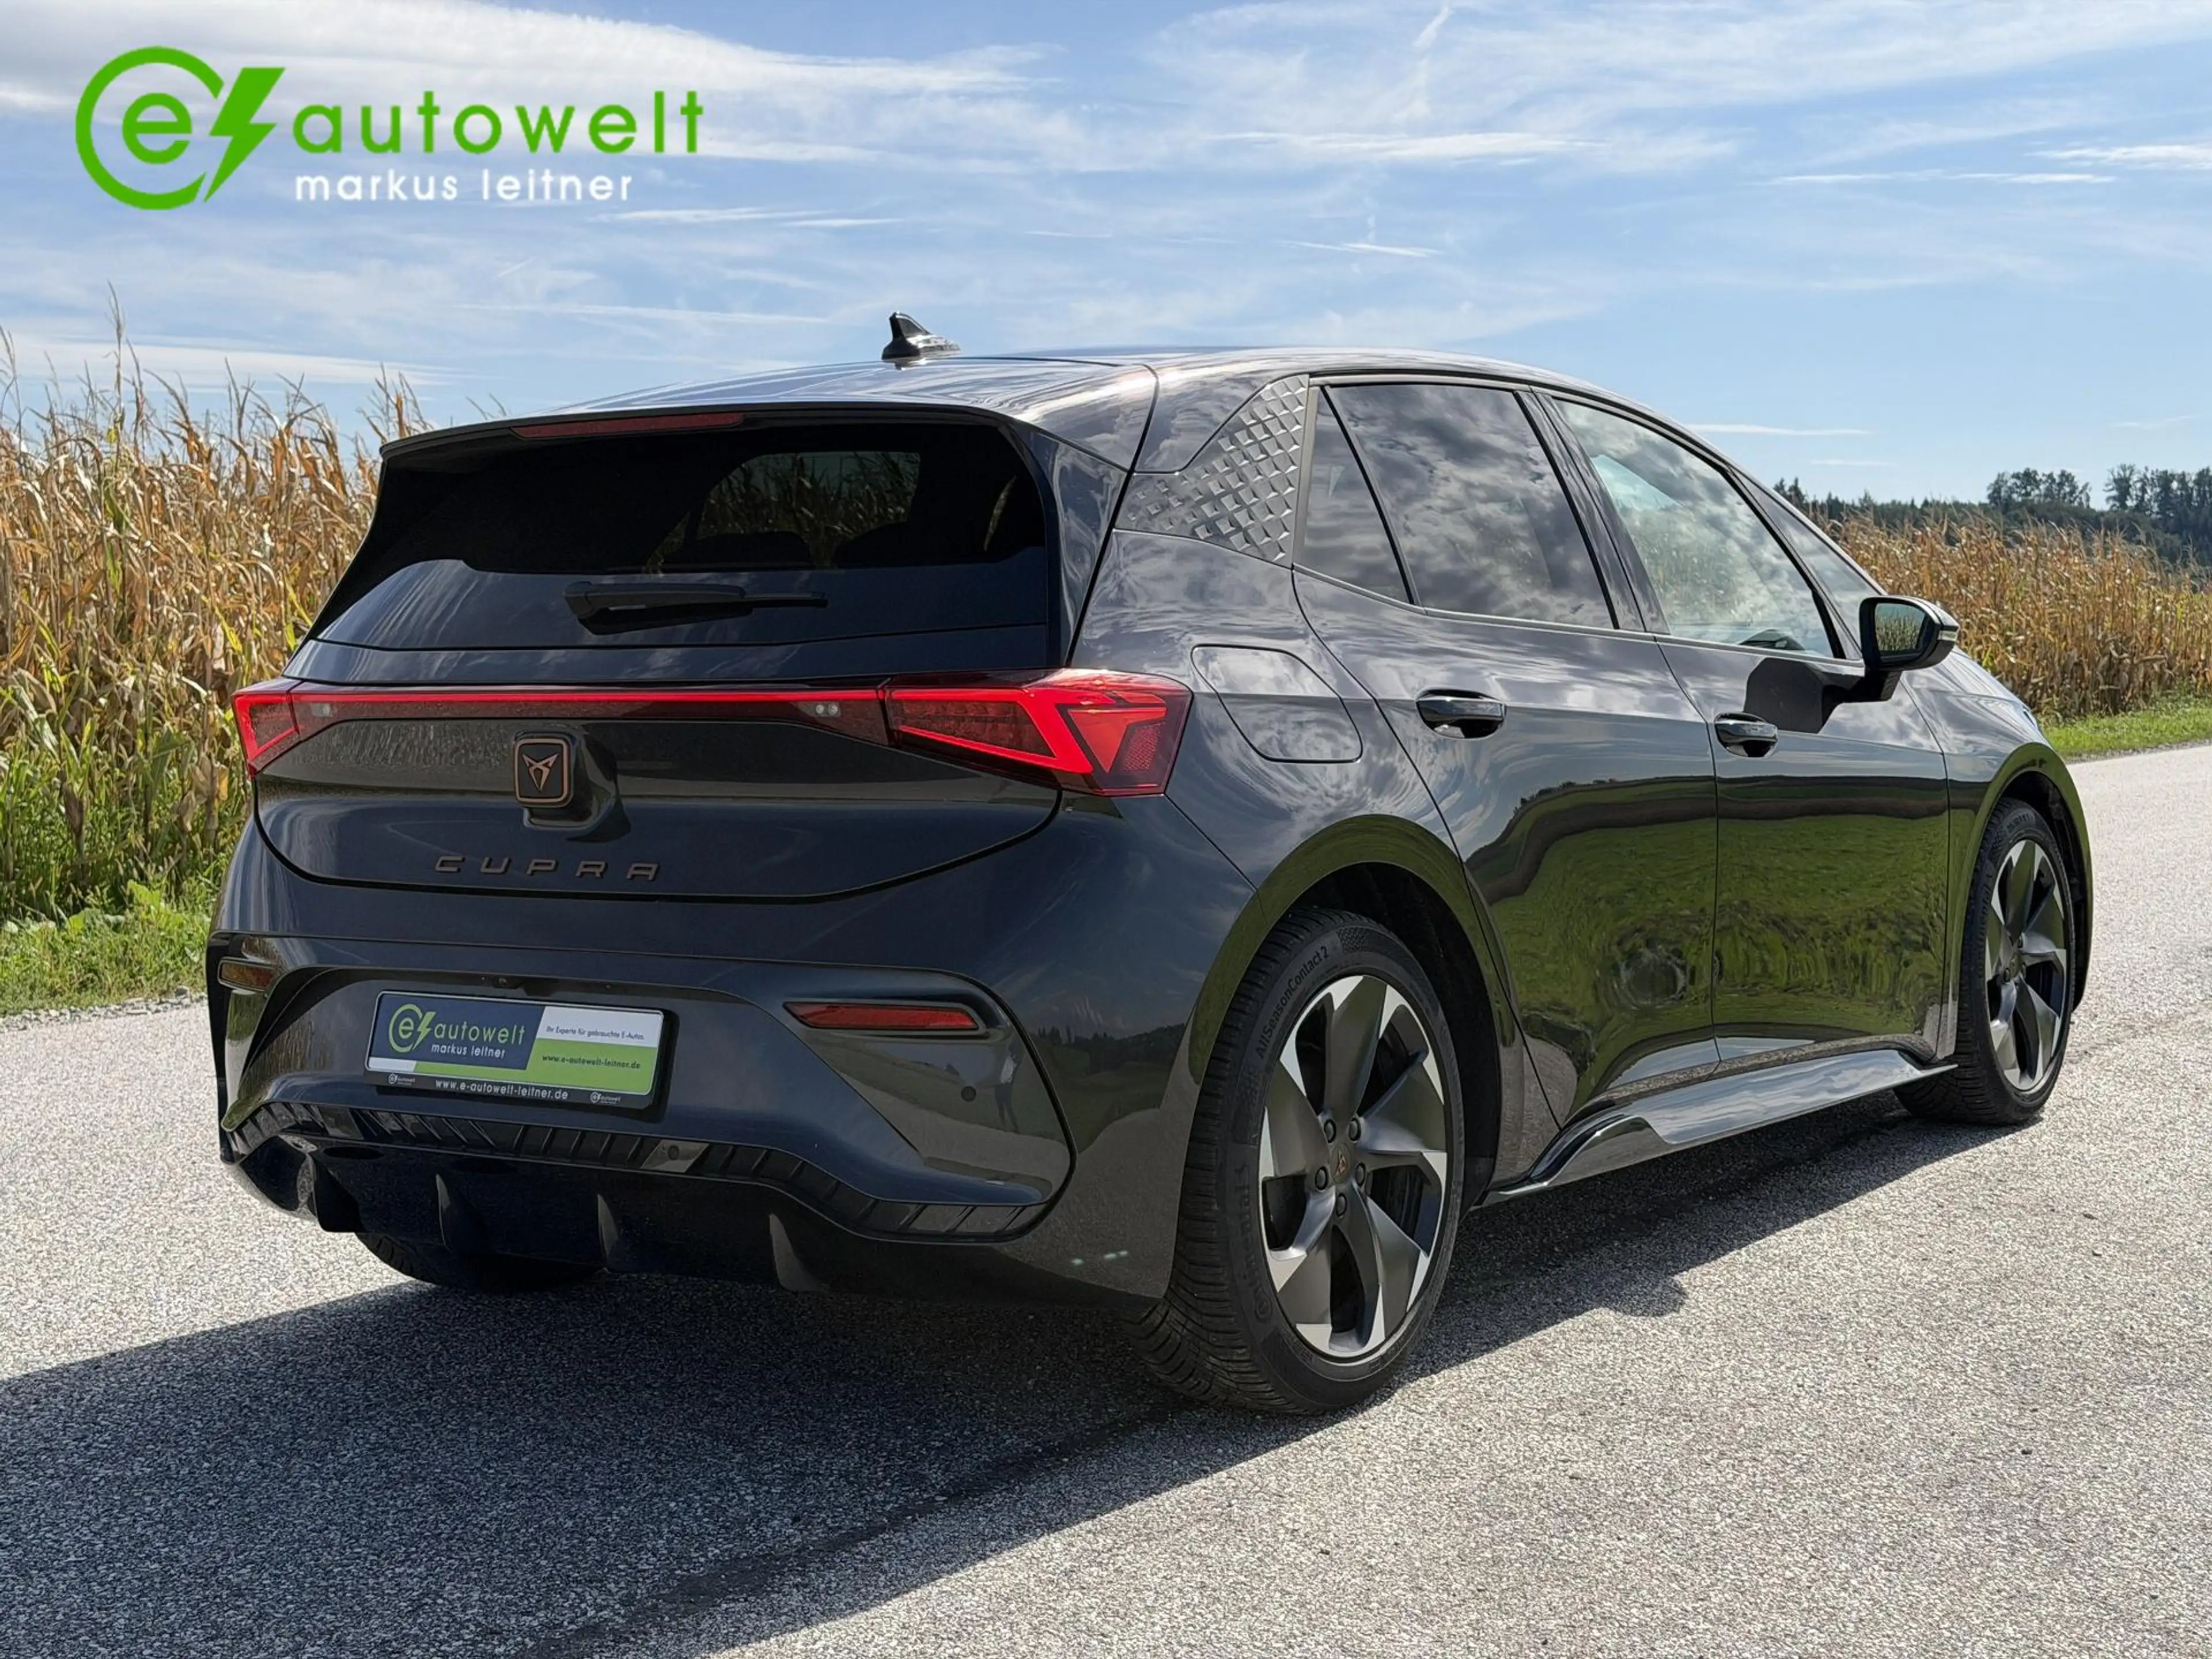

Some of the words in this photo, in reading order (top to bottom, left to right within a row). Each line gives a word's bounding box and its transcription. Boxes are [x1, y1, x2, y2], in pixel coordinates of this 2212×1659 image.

[434, 855, 660, 881] CUPRA
[1255, 950, 1324, 1059] AllSeasonContact
[434, 1021, 525, 1046] autowelt
[430, 1044, 468, 1056] markus
[471, 1045, 506, 1059] leitner
[541, 1055, 641, 1070] www.e-autowelt-leitner.de
[435, 1079, 569, 1101] www.e-autowelt-leitner.de
